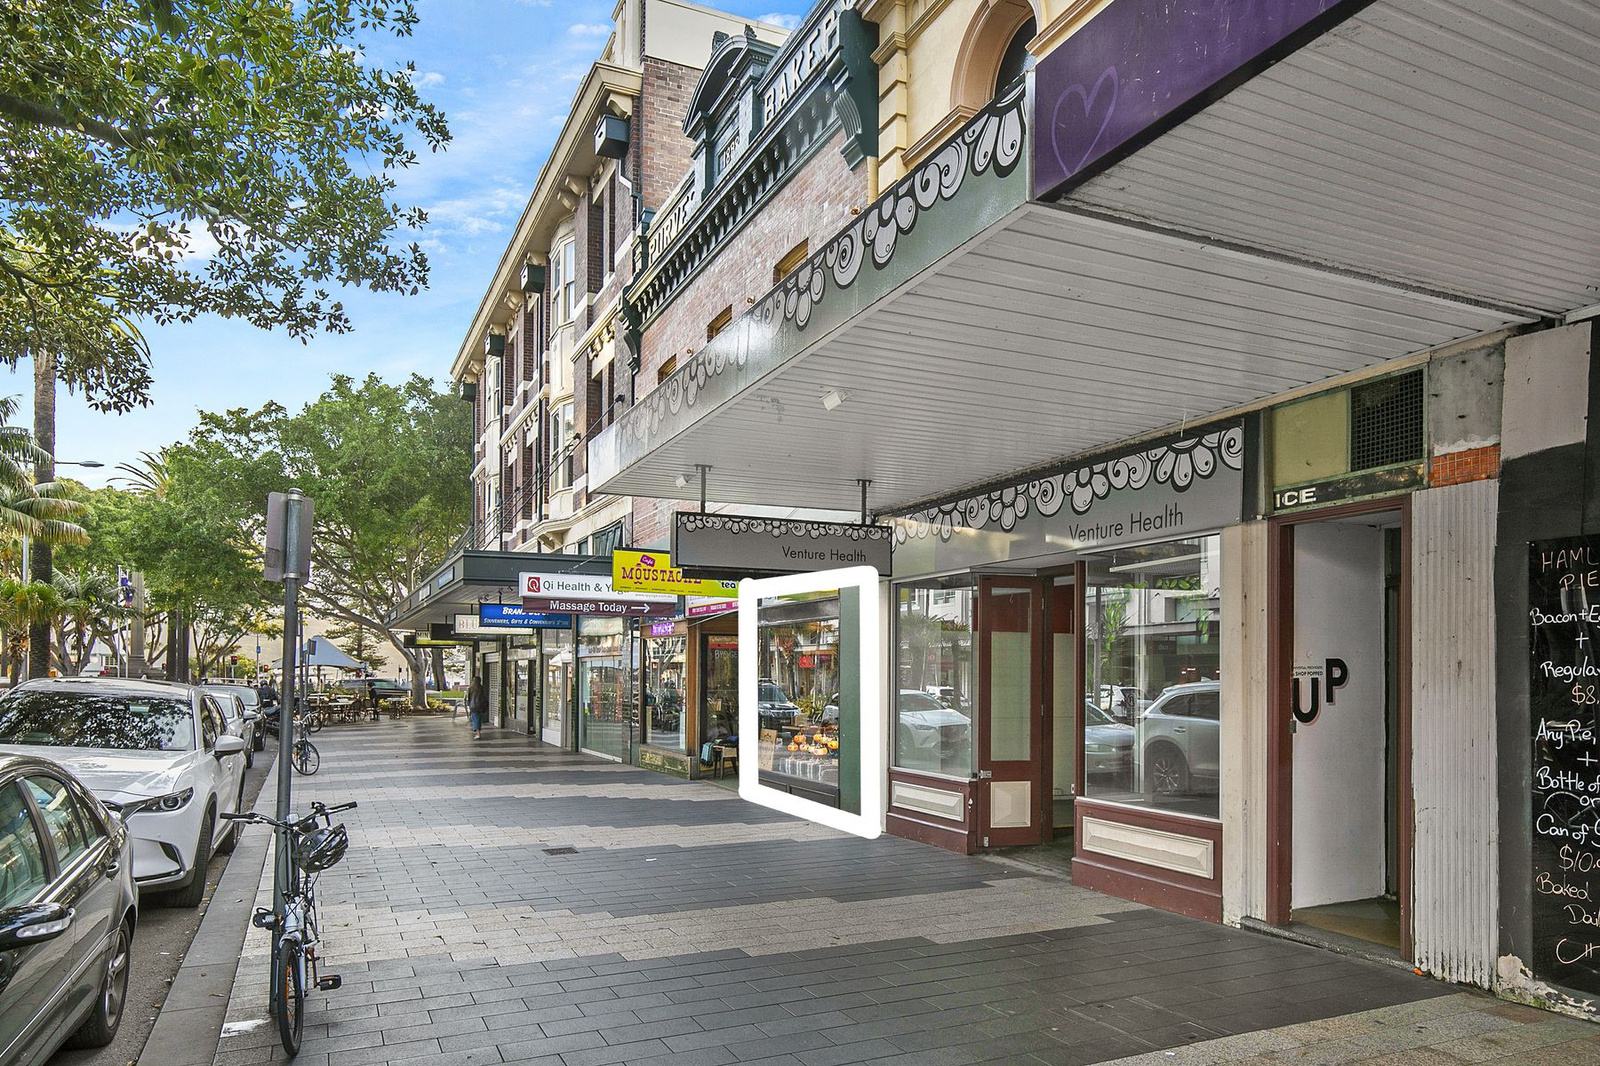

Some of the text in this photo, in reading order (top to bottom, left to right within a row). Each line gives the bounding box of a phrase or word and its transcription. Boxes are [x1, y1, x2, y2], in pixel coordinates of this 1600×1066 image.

[1275, 487, 1317, 508] ICE
[1068, 502, 1184, 543] Venture Health
[781, 545, 867, 562] Venture Health
[621, 566, 702, 585] MOUSTAC
[721, 581, 736, 589] tea
[1559, 570, 1600, 592] PIE
[542, 580, 554, 592] Qi
[557, 581, 591, 592] Health
[593, 582, 603, 593] &
[502, 606, 527, 616] BRAN
[549, 600, 628, 614] Massage Today
[1535, 717, 1564, 750] Any
[1536, 765, 1585, 791] Bottle
[1536, 813, 1569, 837] Can
[1572, 823, 1590, 845] of
[1535, 871, 1593, 903] Baked
